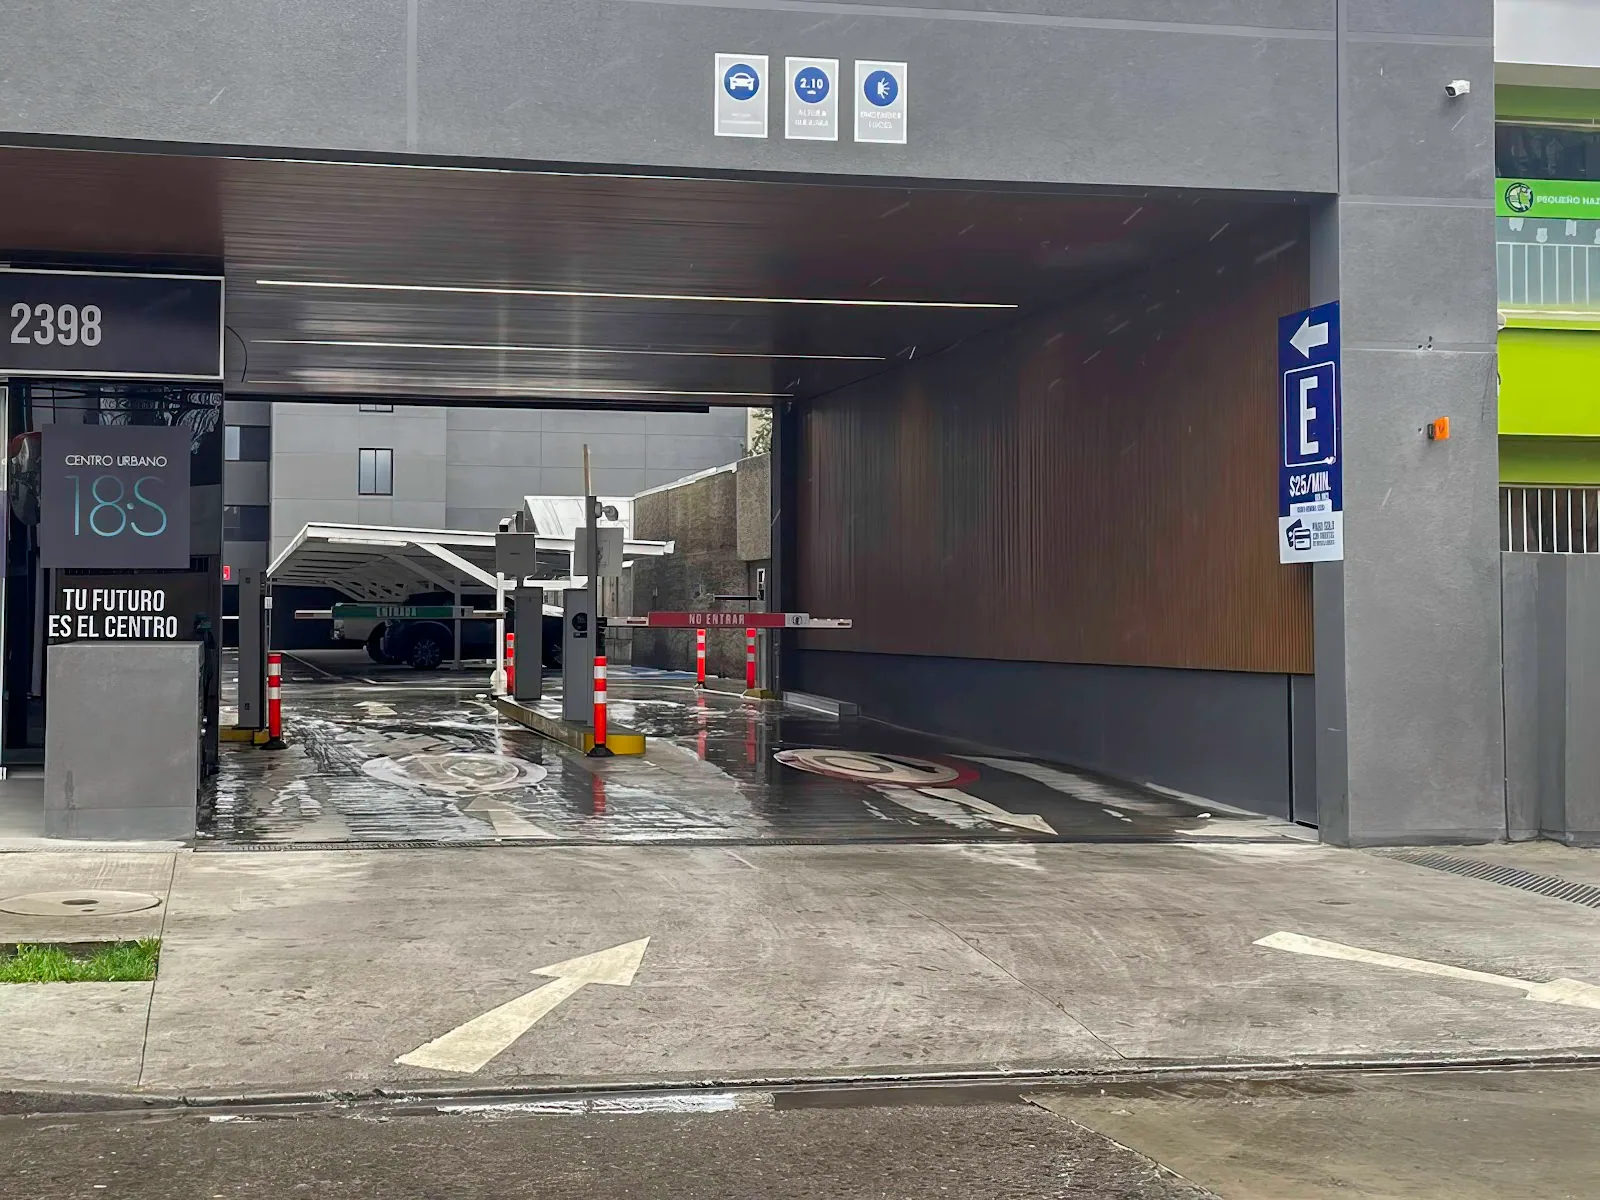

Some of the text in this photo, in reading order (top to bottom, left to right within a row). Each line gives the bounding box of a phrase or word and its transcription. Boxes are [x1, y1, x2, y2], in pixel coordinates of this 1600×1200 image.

[800, 77, 824, 89] 2.10
[1536, 195, 1580, 204] PEQUEÑO
[10, 303, 102, 346] 2398
[1299, 376, 1319, 456] E
[65, 454, 168, 467] CENTRO URBANO
[63, 589, 165, 612] TU FUTURO
[48, 615, 178, 638] ES EL CENTRO
[689, 613, 745, 625] NO ENTRAR
